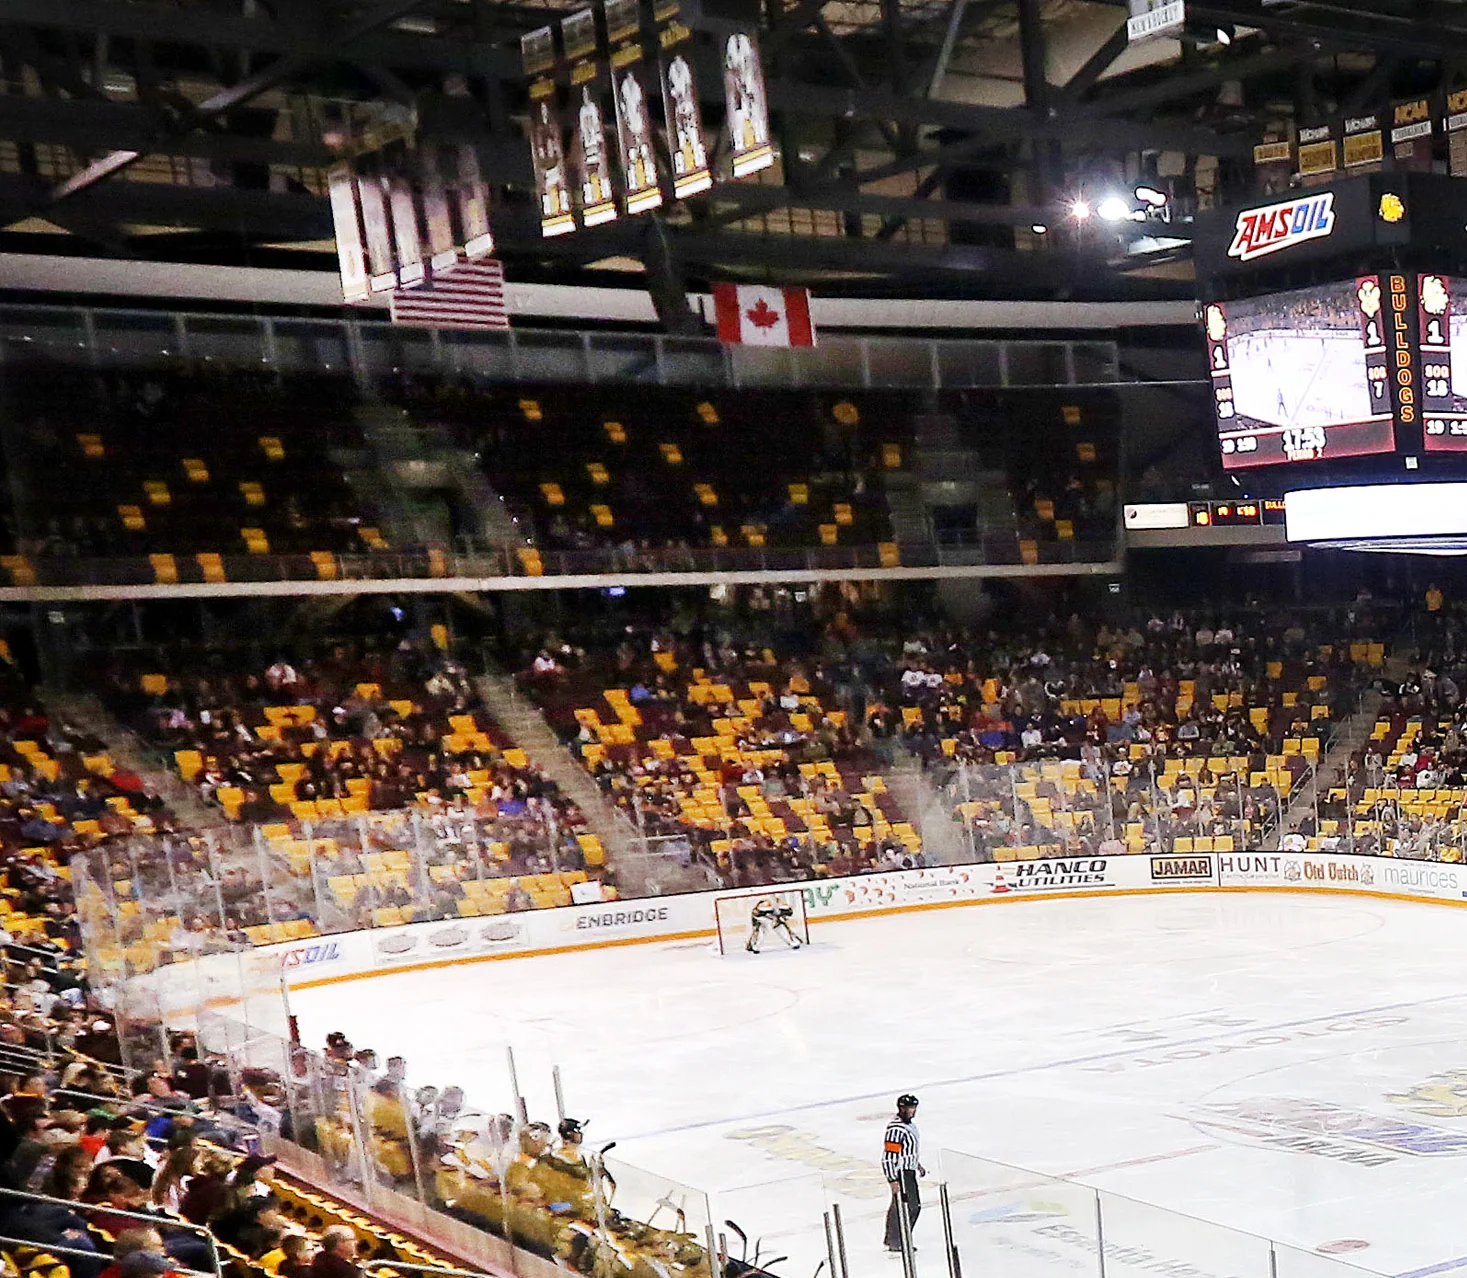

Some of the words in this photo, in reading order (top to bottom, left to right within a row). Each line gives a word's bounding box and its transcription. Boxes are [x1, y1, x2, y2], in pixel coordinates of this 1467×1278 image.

[1234, 196, 1331, 253] AMSOIL
[1367, 321, 1381, 345] 1
[1427, 320, 1444, 344] 1
[1213, 346, 1227, 368] 1
[1390, 275, 1415, 422] BULLDOGS
[1016, 860, 1107, 877] HANCO
[1153, 860, 1209, 876] JAMAR
[1221, 857, 1281, 872] HUNT
[1304, 862, 1325, 881] Old
[1018, 873, 1105, 887] UTILITIES
[1384, 865, 1458, 889] maurices
[576, 907, 668, 929] ENBRIDGE
